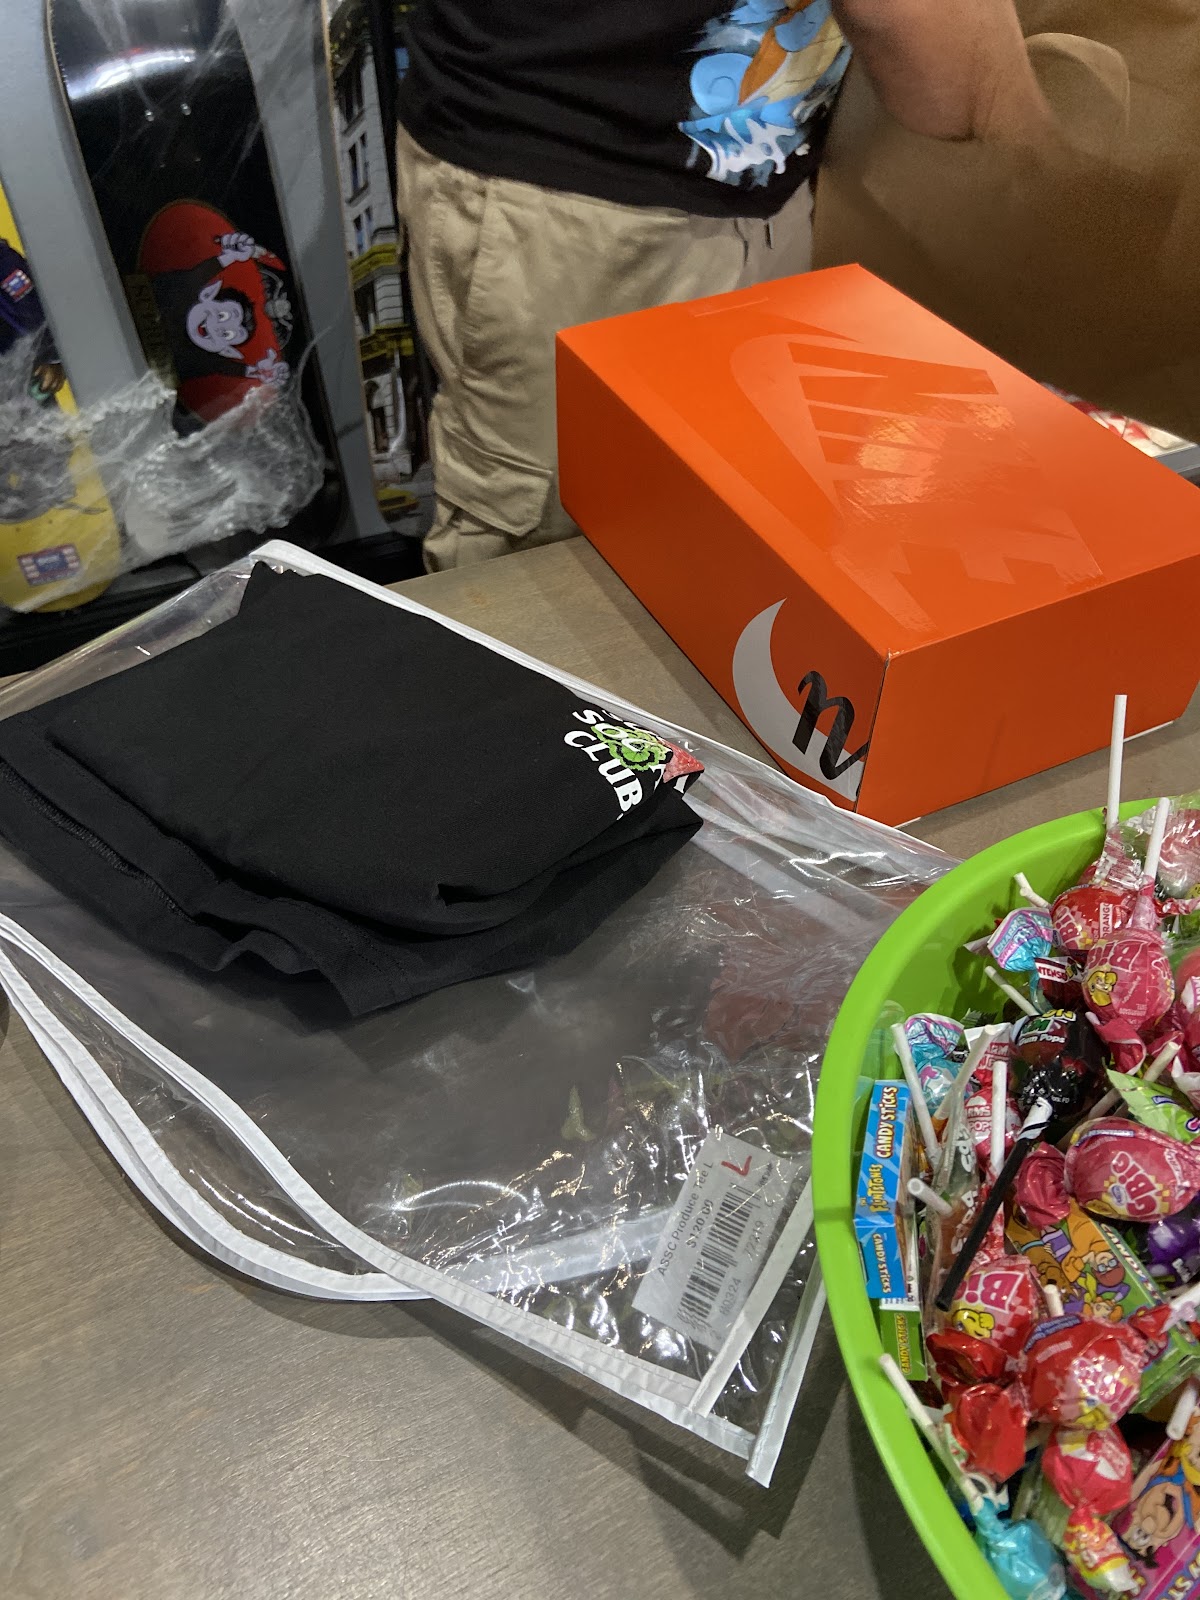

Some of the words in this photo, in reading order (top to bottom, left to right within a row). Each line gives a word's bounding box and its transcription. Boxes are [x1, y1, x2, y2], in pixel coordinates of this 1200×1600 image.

[564, 730, 643, 812] CLUB
[1039, 1033, 1066, 1045] Pops
[876, 1119, 895, 1159] CANDY
[721, 1155, 753, 1177] L
[657, 1241, 678, 1277] ASSC
[673, 1199, 699, 1240] Produce
[695, 1172, 710, 1191] Tee
[872, 1233, 886, 1263] CANDY
[898, 1344, 912, 1375] CANDY
